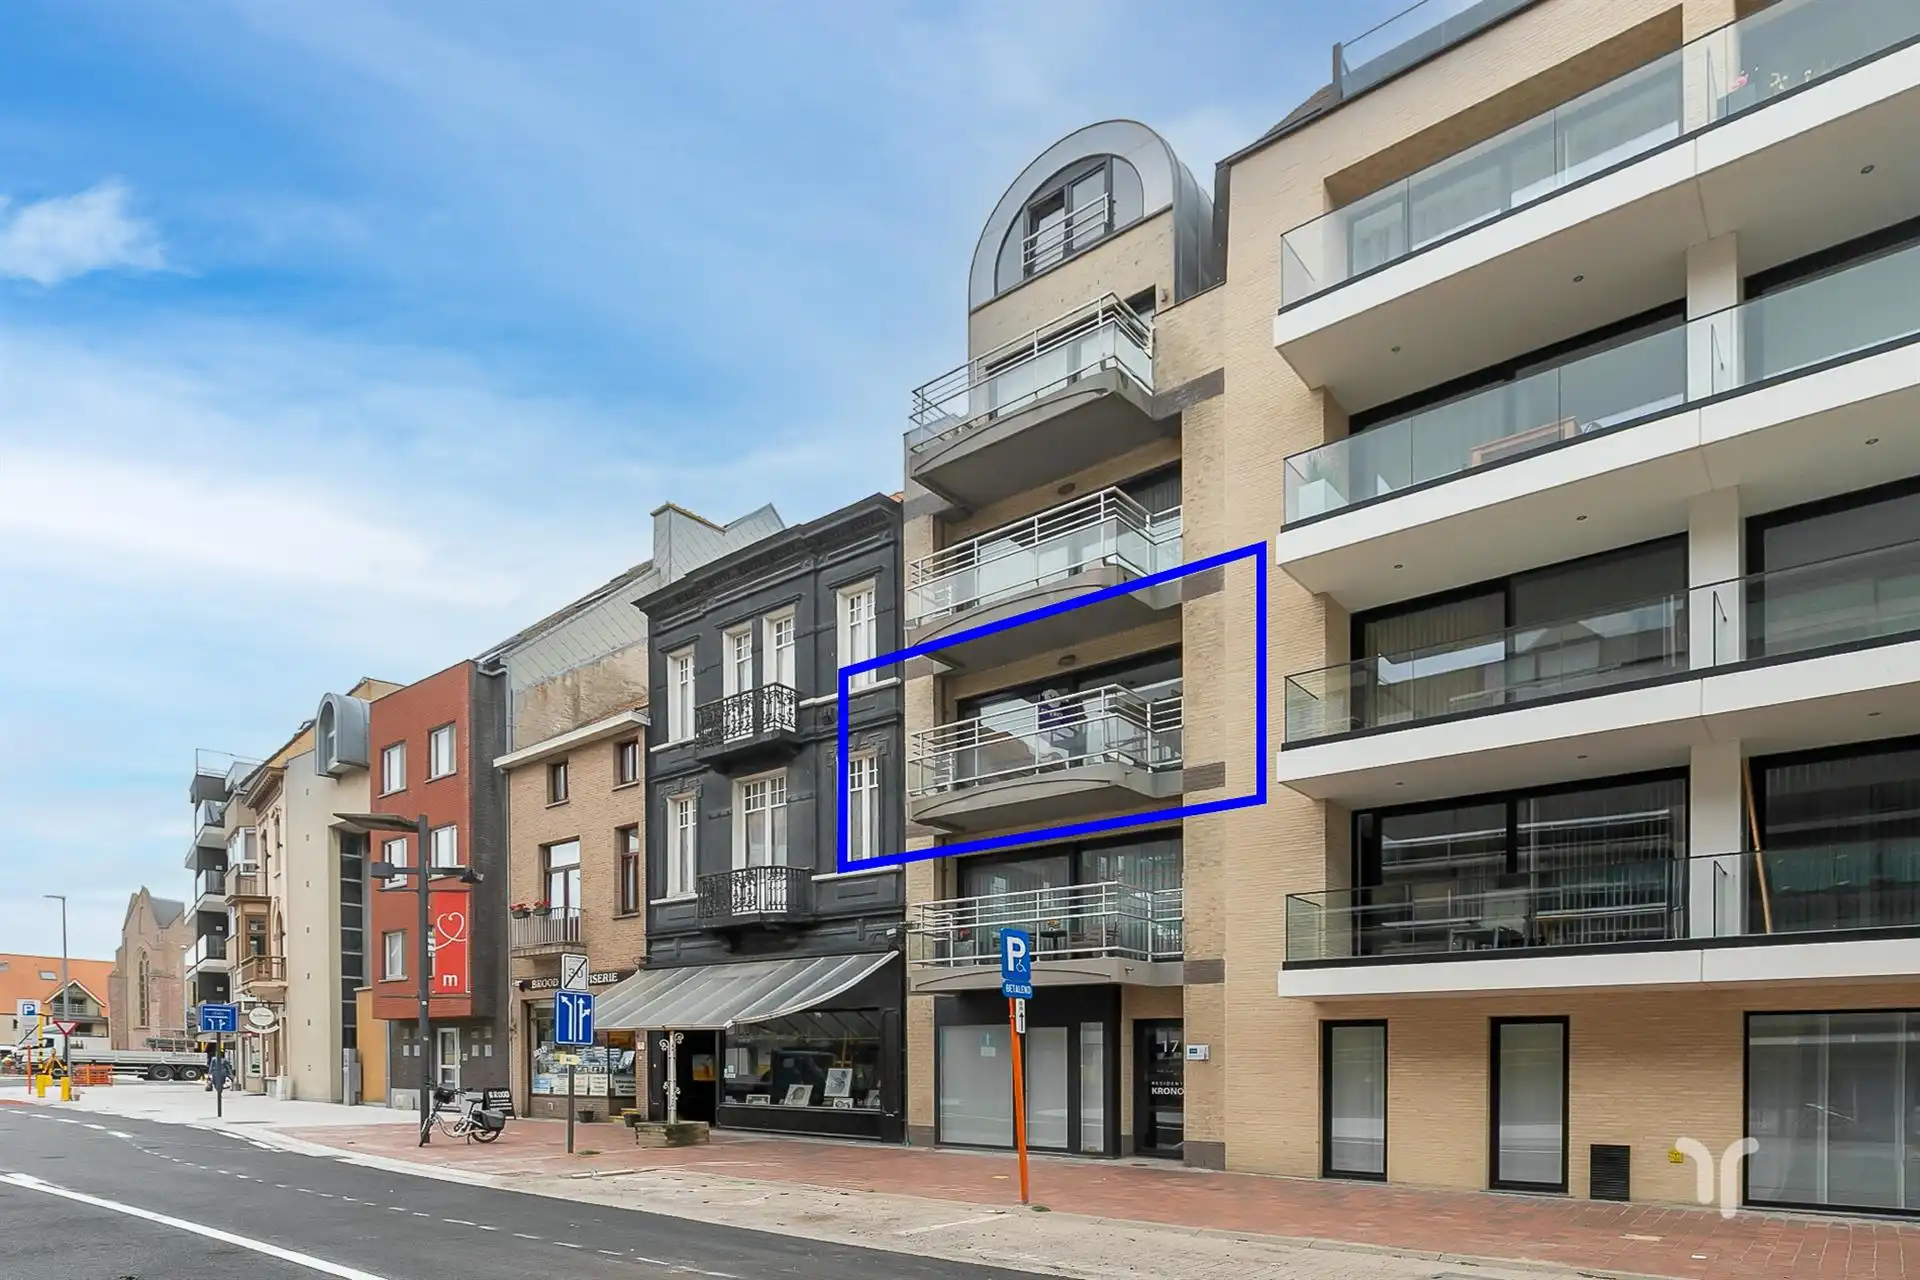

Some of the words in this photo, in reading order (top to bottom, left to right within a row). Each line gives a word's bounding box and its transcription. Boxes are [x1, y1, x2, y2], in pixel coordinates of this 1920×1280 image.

[1006, 936, 1026, 971] P
[568, 967, 584, 979] 30
[442, 974, 458, 986] m
[531, 977, 559, 989] BROOD
[23, 1004, 35, 1015] P
[1162, 1040, 1179, 1053] 17
